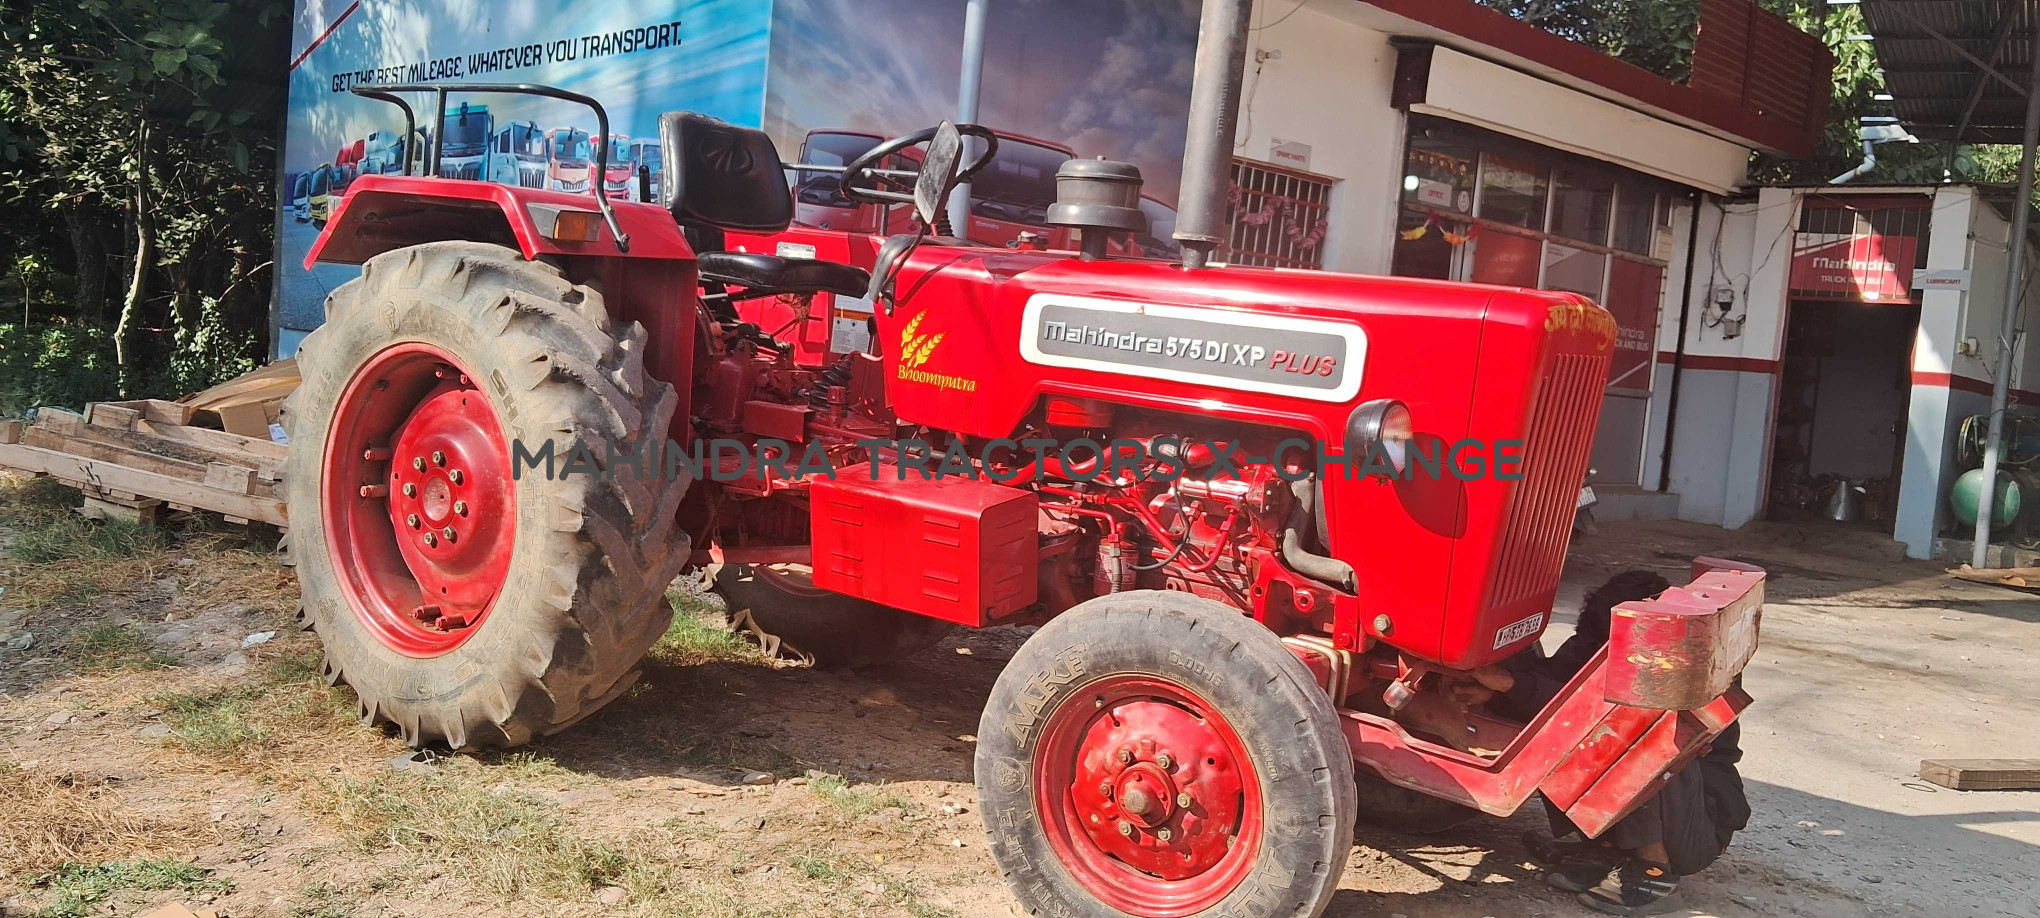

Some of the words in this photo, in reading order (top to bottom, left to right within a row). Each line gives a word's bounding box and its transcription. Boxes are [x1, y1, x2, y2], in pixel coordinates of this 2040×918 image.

[332, 72, 352, 93] GET
[354, 69, 375, 84] THE
[376, 65, 406, 84] BEST
[408, 56, 465, 84] MILEAGE,
[468, 44, 542, 75] WHATEVER
[546, 38, 578, 63] YOU
[581, 21, 682, 59] TRANSPORT.
[1820, 274, 1847, 284] TRUCK
[1044, 320, 1163, 354] Mahindra
[1165, 336, 1203, 360] 575
[1232, 343, 1266, 367] XP
[1268, 349, 1337, 377] PLUS
[1617, 324, 1645, 340] hindra
[897, 364, 976, 392] Bhoomiputra
[1002, 642, 1087, 749] MRF
